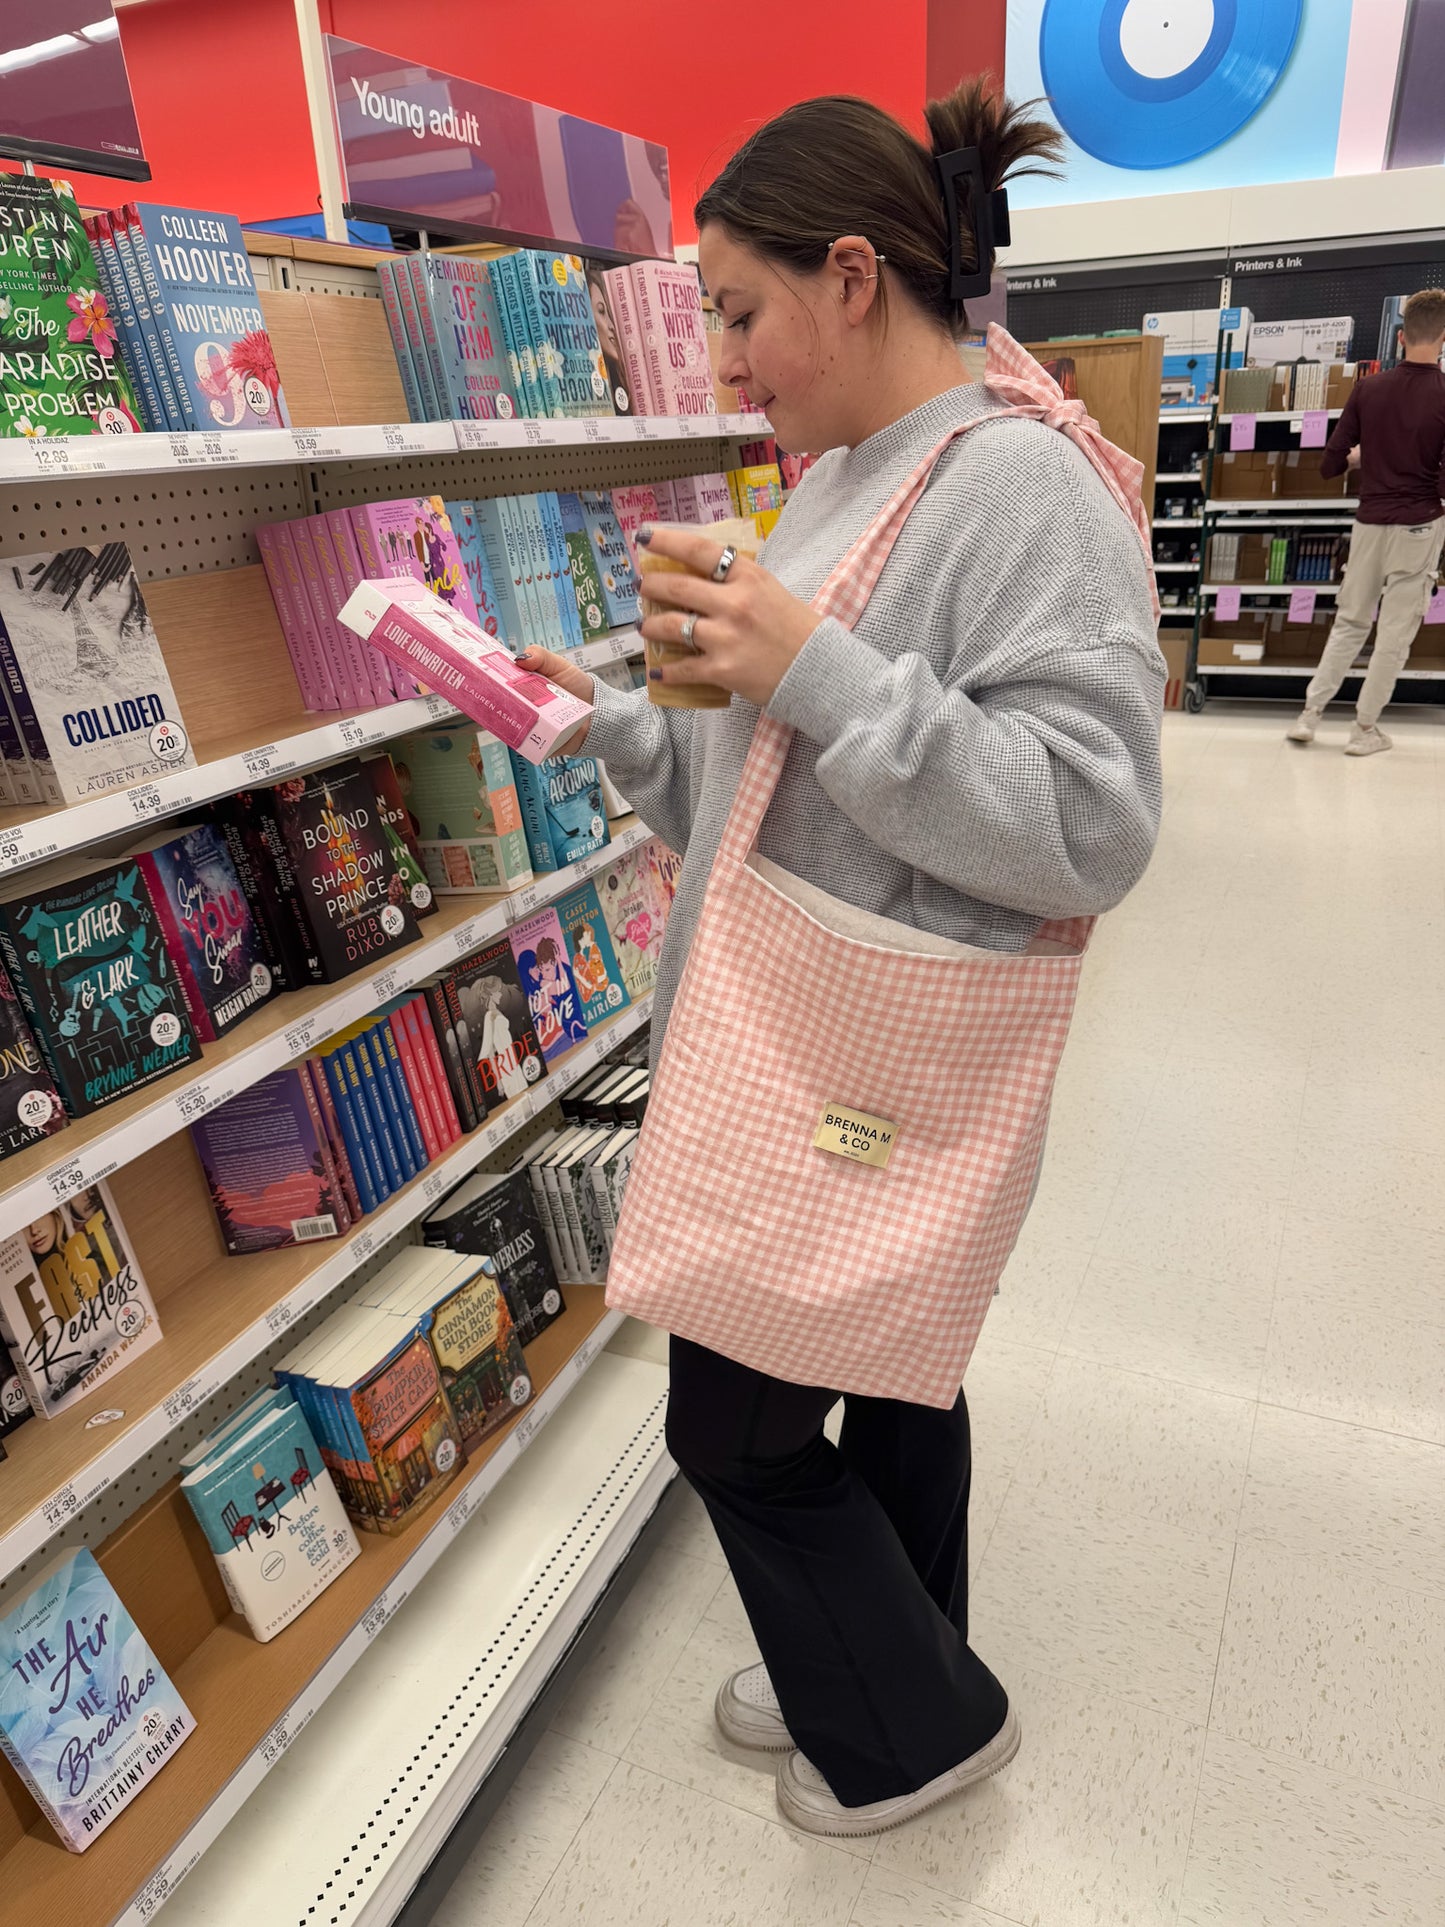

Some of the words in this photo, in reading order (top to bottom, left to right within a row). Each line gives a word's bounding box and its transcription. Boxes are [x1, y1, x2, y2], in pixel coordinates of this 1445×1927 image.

[350, 76, 425, 139] Young
[429, 106, 481, 147] adult
[161, 214, 228, 244] COLLEEN
[7, 268, 29, 278] YORK
[32, 271, 57, 280] TIMES
[155, 244, 251, 287] HOOVER
[425, 258, 491, 284] REMINDERS
[535, 258, 549, 286] IT
[1235, 259, 1275, 272] Printers
[1276, 258, 1285, 269] &
[1285, 256, 1303, 268] Ink
[37, 284, 73, 293] AUTHOR
[658, 282, 671, 308] IT
[673, 284, 700, 311] ENDS
[1033, 278, 1041, 289] &
[1043, 277, 1057, 288] Ink
[452, 284, 477, 322] OF
[539, 290, 588, 319] STARTS
[14, 306, 60, 340] The
[129, 224, 160, 299] NOVEMBER
[162, 329, 180, 374] COLLEEN
[175, 375, 193, 414] HOOVER
[172, 304, 263, 335] NOVEMBER
[662, 312, 695, 339] WITH
[1253, 325, 1285, 336] EPSON
[454, 325, 494, 361] HIM
[545, 323, 579, 350] WITH
[581, 326, 600, 350] US
[668, 343, 686, 368] US
[194, 341, 246, 427] 9
[464, 375, 500, 390] COLLEEN
[5, 392, 116, 417] PROBLEM
[294, 438, 317, 450] 13.59
[385, 434, 404, 445] 13.59
[35, 450, 69, 465] 12.89
[585, 501, 614, 515] THINGS
[618, 492, 655, 510] THINGS
[701, 489, 729, 505] THINGS
[600, 522, 613, 536] WE
[620, 517, 637, 531] WE
[712, 509, 724, 522] WE
[599, 544, 627, 559] NEVER
[610, 564, 628, 578] GOT
[383, 621, 413, 649] LOVE
[407, 638, 465, 690] UNWRITTEN
[464, 684, 495, 711] LAUREN
[497, 709, 521, 731] ASHER
[62, 693, 167, 747] COLLIDED
[342, 727, 364, 741] 15.19
[77, 770, 136, 796] LAUREN
[142, 757, 187, 778] ASHER
[246, 758, 270, 774] 14.39
[550, 759, 596, 806] AROUND
[132, 794, 162, 813] 14.39
[302, 808, 369, 850] BOUND
[327, 849, 340, 862] TO
[342, 840, 362, 855] THE
[566, 847, 585, 862] EMILY
[587, 837, 604, 852] RATH
[311, 849, 385, 896] SHADOW
[177, 877, 204, 920] Say
[325, 876, 389, 919] PRINCE
[565, 902, 587, 920] CASEY
[53, 901, 125, 961] LEATHER
[181, 889, 245, 949] YOU
[514, 911, 555, 936] HAZELWOOD
[205, 929, 242, 985] Swear
[462, 942, 510, 971] HAZELWOOD
[81, 982, 97, 1010] &
[97, 955, 139, 1001] LARK
[375, 981, 395, 998] 15.19
[630, 968, 651, 988] Tillie
[215, 994, 243, 1027] MEAGAN
[536, 994, 574, 1048] LOVE
[288, 1032, 311, 1051] 15.19
[85, 1063, 137, 1102] BRYNNE
[142, 1034, 192, 1072] WEAVER
[476, 1031, 538, 1093] BRIDE
[179, 1095, 207, 1117] 15.20
[825, 1114, 877, 1140] BRENNA
[880, 1132, 891, 1144] M
[839, 1134, 848, 1145] &
[851, 1137, 870, 1151] CO
[46, 1158, 81, 1182] GRIMSTONE
[51, 1170, 84, 1197] 14.39
[354, 1239, 373, 1260] 13.59
[14, 1209, 122, 1347] FAST
[437, 1284, 497, 1340] CINNAMON
[456, 1292, 473, 1309] The
[24, 1265, 138, 1385] Reckless
[270, 1309, 291, 1332] 14.40
[442, 1323, 468, 1352] BUN
[469, 1301, 499, 1333] BOOK
[457, 1321, 493, 1355] STORE
[81, 1350, 120, 1391] AMANDA
[387, 1366, 405, 1385] The
[372, 1360, 426, 1417] PUMPKIN
[166, 1394, 192, 1419] 14.40
[371, 1400, 407, 1440] SPICE
[42, 1499, 53, 1512] 7TH
[53, 1483, 73, 1501] CIRCLE
[46, 1494, 76, 1524] 14.39
[287, 1506, 320, 1537] Before
[300, 1521, 316, 1538] the
[451, 1505, 469, 1528] 15.19
[299, 1522, 327, 1553] coffee
[306, 1536, 327, 1560] gets
[310, 1547, 330, 1567] cold
[265, 1588, 311, 1633] TOSHIKAZU
[12, 1637, 57, 1685] THE
[49, 1613, 109, 1714] Air
[76, 1686, 105, 1721] HE
[57, 1668, 155, 1797] Breathes
[262, 1730, 288, 1762] 13.59
[82, 1761, 146, 1832] BRITTAINY
[145, 1715, 186, 1765] CHERRY
[85, 1766, 124, 1807] INTERNATIONAL
[134, 1892, 146, 1905] THE
[146, 1880, 156, 1892] AIR
[156, 1869, 164, 1881] HE
[139, 1879, 169, 1916] 13.59
